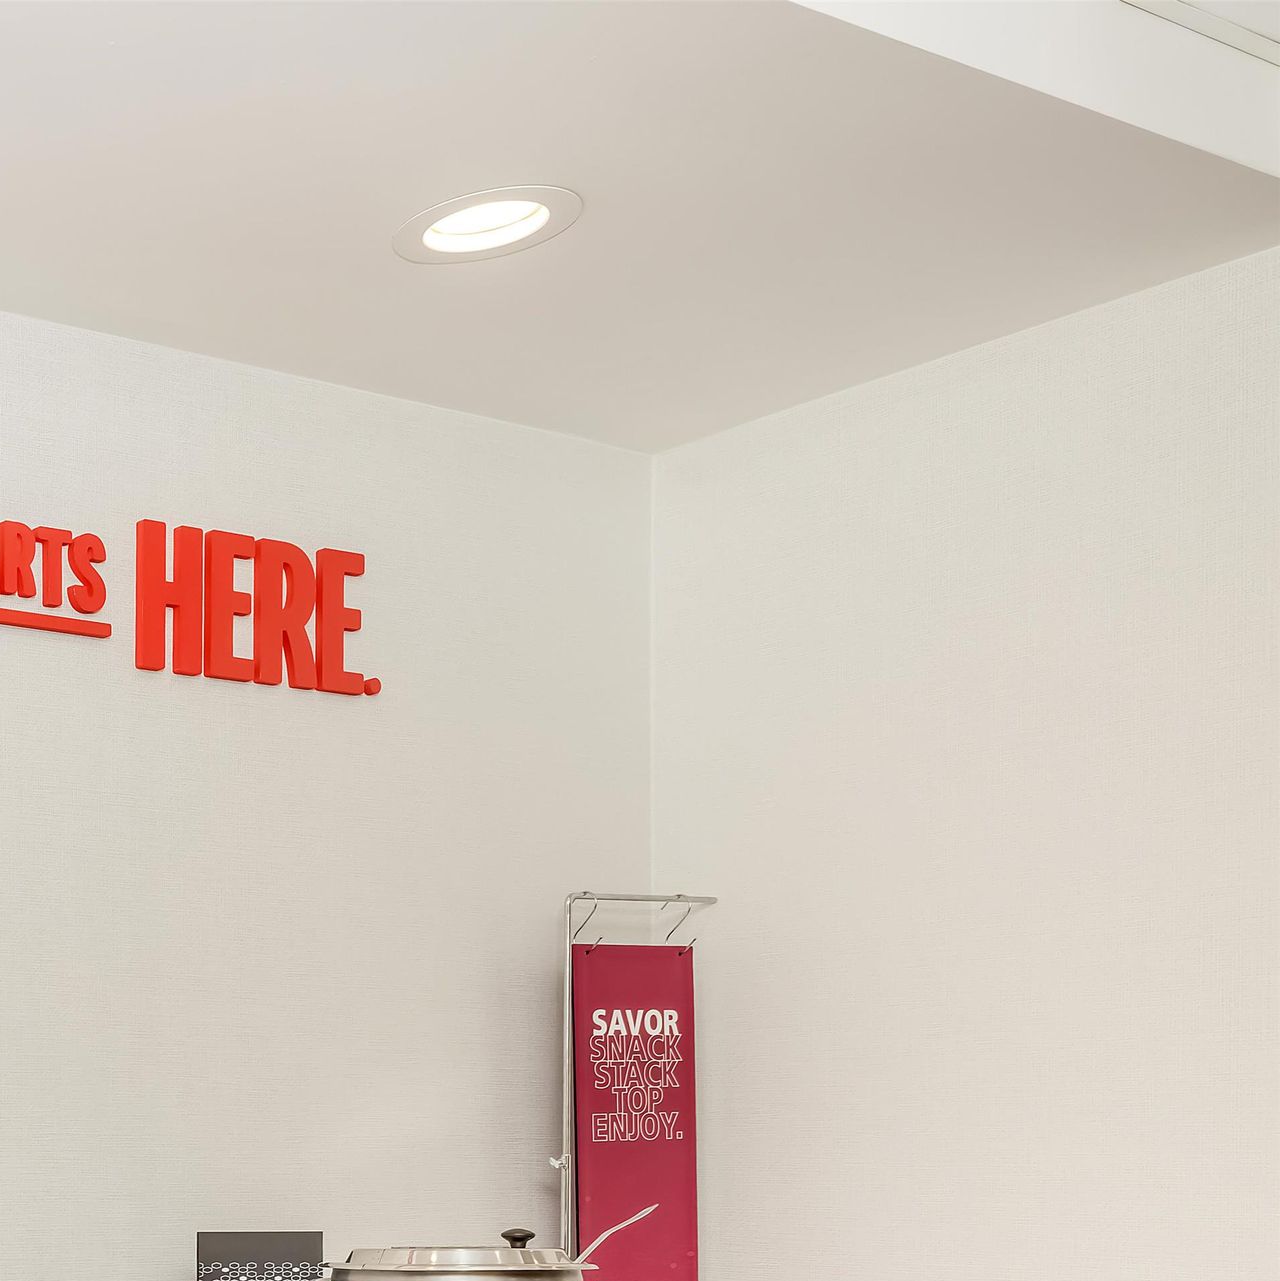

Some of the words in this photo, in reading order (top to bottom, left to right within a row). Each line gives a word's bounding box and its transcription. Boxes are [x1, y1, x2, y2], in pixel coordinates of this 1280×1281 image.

[134, 518, 382, 697] HERE.
[592, 1008, 679, 1036] SAVOR
[589, 1033, 683, 1062] SNACK
[593, 1060, 680, 1089] STACK
[611, 1086, 664, 1115] TOP
[591, 1111, 684, 1142] ENJOY.
